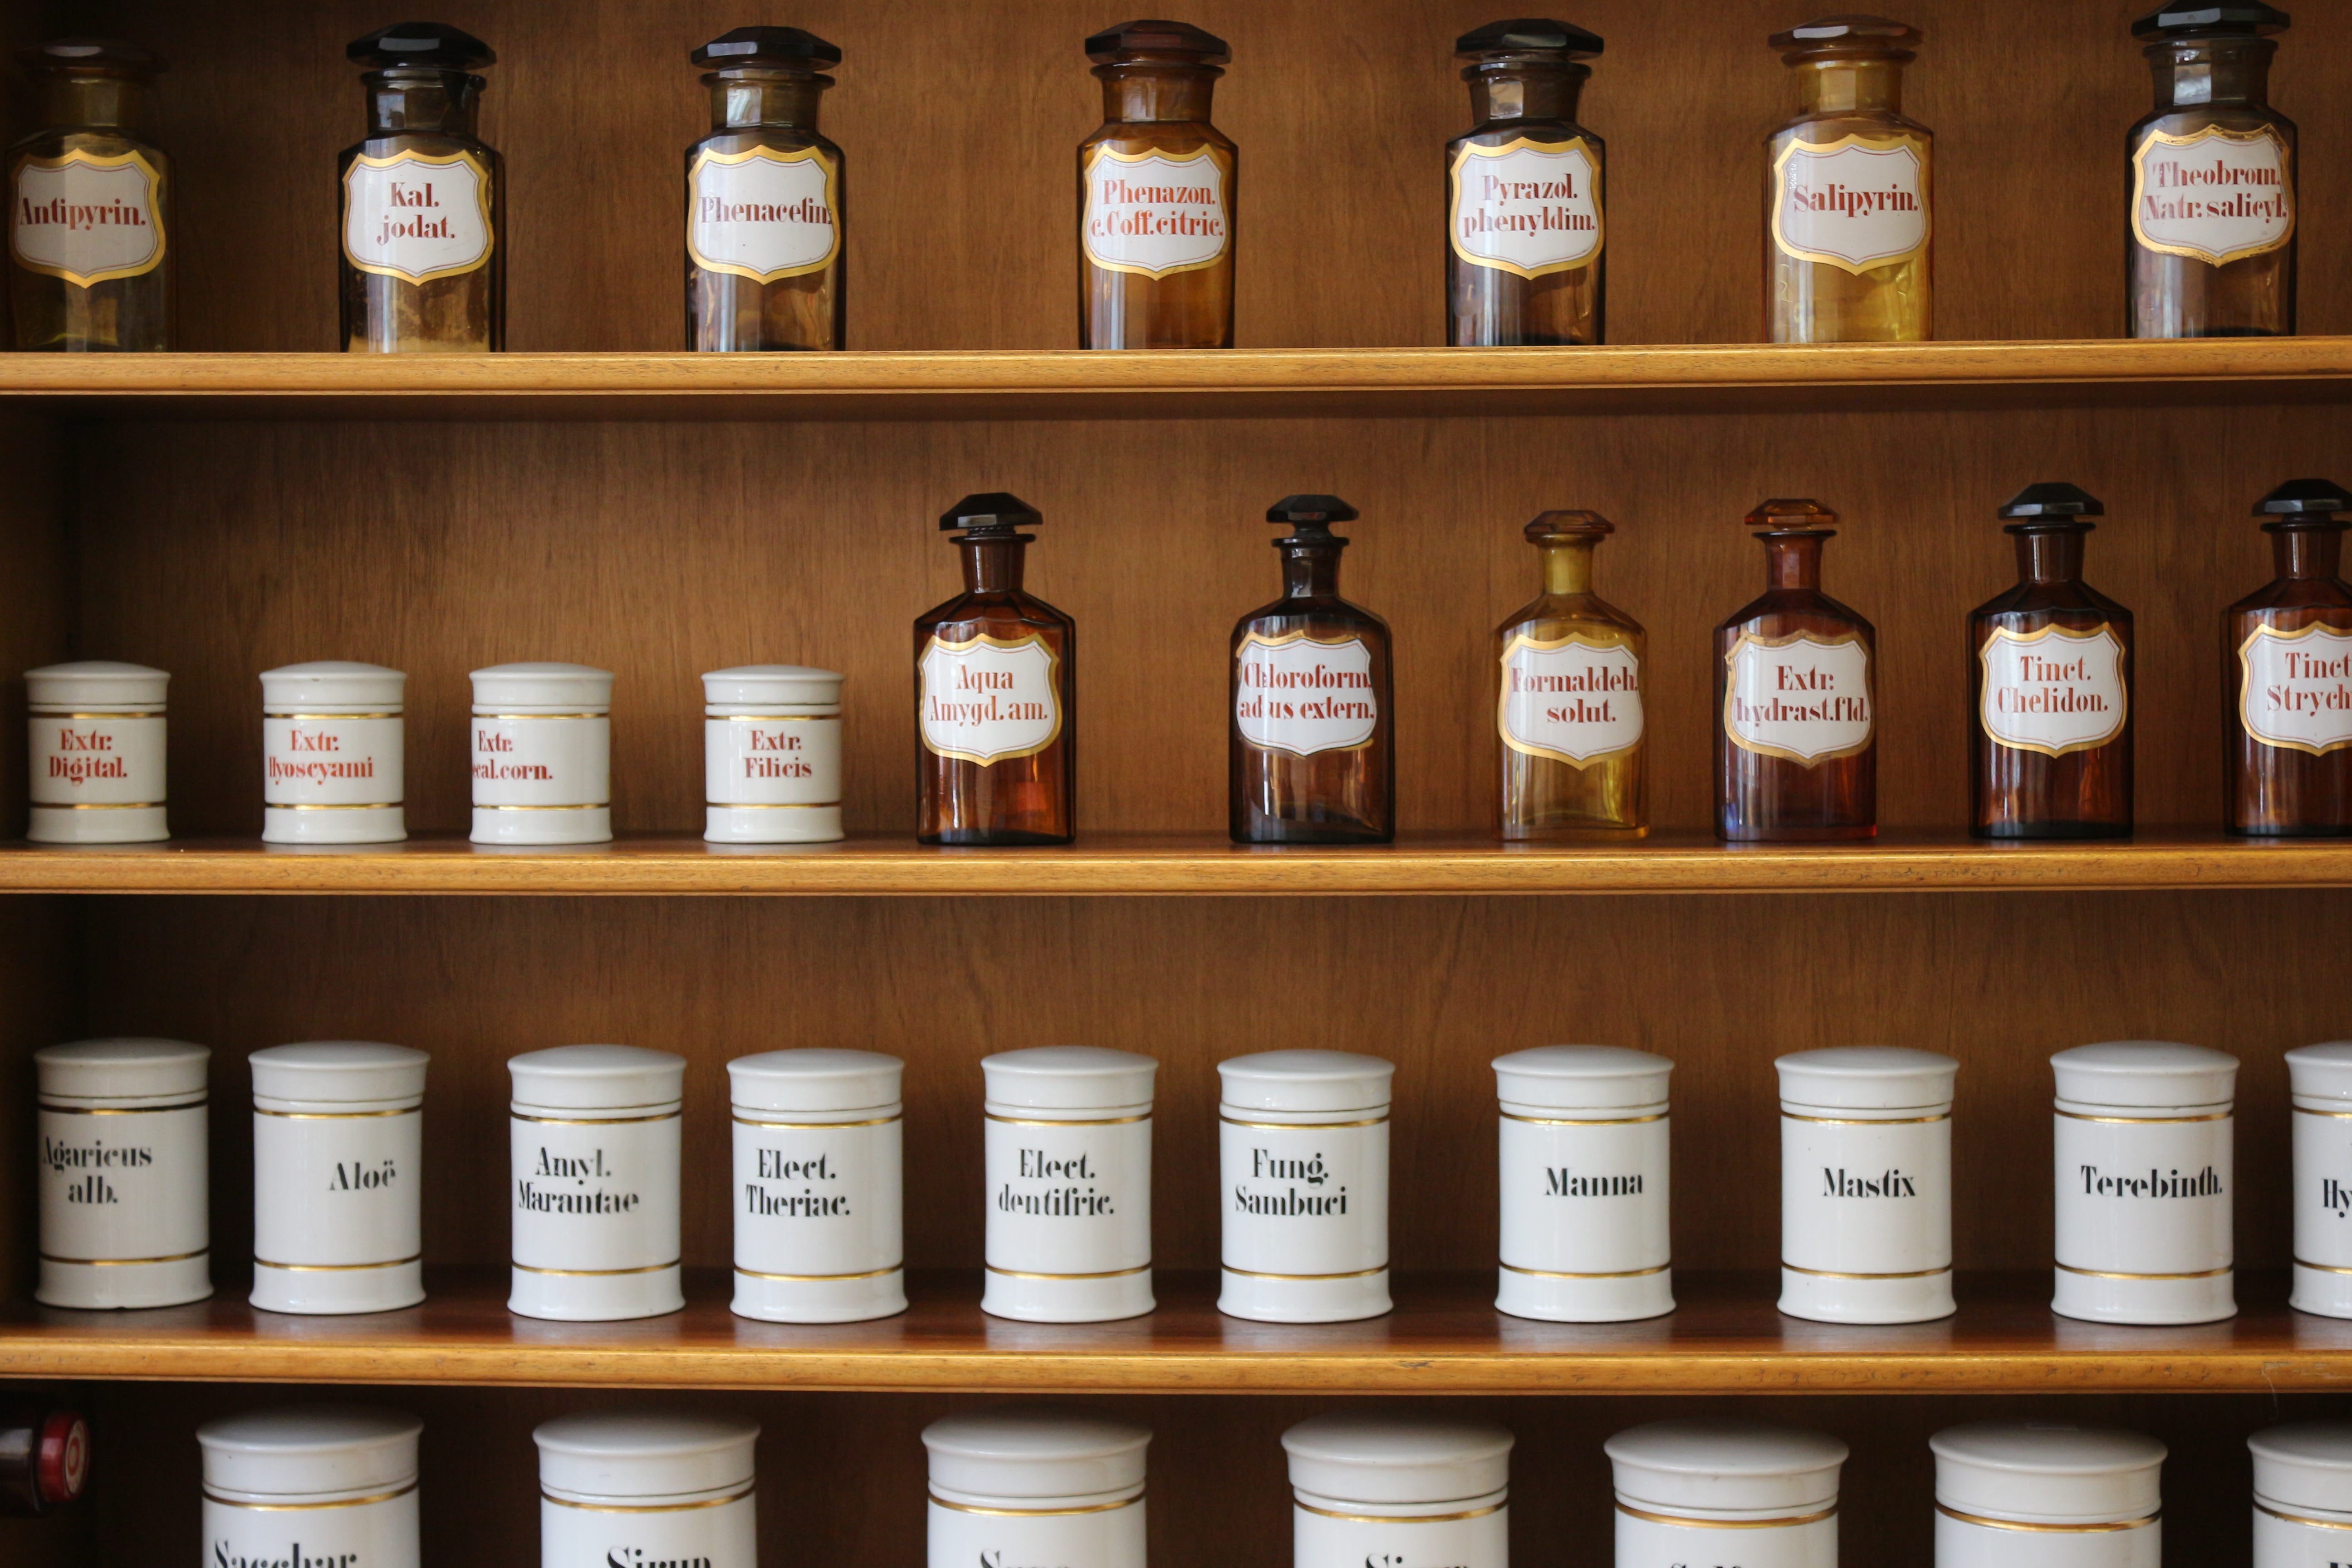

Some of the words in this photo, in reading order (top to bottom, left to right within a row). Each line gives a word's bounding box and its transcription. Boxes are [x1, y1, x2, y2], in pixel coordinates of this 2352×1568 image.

[2152, 160, 2281, 188] Theobrom.
[389, 181, 440, 208] Kal.
[1103, 179, 1216, 206] Phenazon.
[1481, 173, 1578, 206] Pyrazol.
[1793, 183, 1918, 218] Salipyrin.
[20, 198, 146, 231] Antipyrin.
[700, 196, 832, 225] Phenacetin.
[1463, 206, 1596, 239] phenyldim.
[377, 214, 456, 246] jodat.
[957, 665, 1013, 691] Aqua
[1244, 663, 1372, 689] Chloroform.
[1511, 666, 1638, 692] Formaldeh.
[1777, 666, 1834, 691] Extr.
[2020, 656, 2091, 681] Tinct.
[1240, 695, 1263, 719] ad
[1269, 701, 1294, 719] us
[1300, 696, 1374, 720] extern.
[1547, 699, 1616, 723] solut.
[1998, 687, 2108, 713] Chelidon.
[2267, 684, 2352, 717] Strych
[61, 729, 113, 751] Extr.
[291, 730, 339, 752] Extr.
[478, 730, 513, 752] Extr.
[751, 730, 802, 750] Extr.
[49, 756, 127, 785] Digital.
[269, 756, 373, 786] Hyoscyami
[743, 757, 813, 778] Filicis
[44, 1137, 153, 1174] Agaricus
[535, 1147, 611, 1186] Amyl.
[759, 1148, 836, 1180] Elect.
[1020, 1149, 1095, 1179] Elect.
[1253, 1148, 1329, 1186] Fung.
[68, 1175, 118, 1204] alb.
[330, 1160, 396, 1191] Aloë
[1546, 1167, 1642, 1197] Manna
[1823, 1167, 1916, 1198] Mastix
[2081, 1165, 2222, 1198] Terebinth.
[519, 1179, 639, 1214] Marantae
[746, 1184, 850, 1217] Theriac.
[998, 1183, 1114, 1216] dentifric.
[1235, 1183, 1346, 1216] Sambuci
